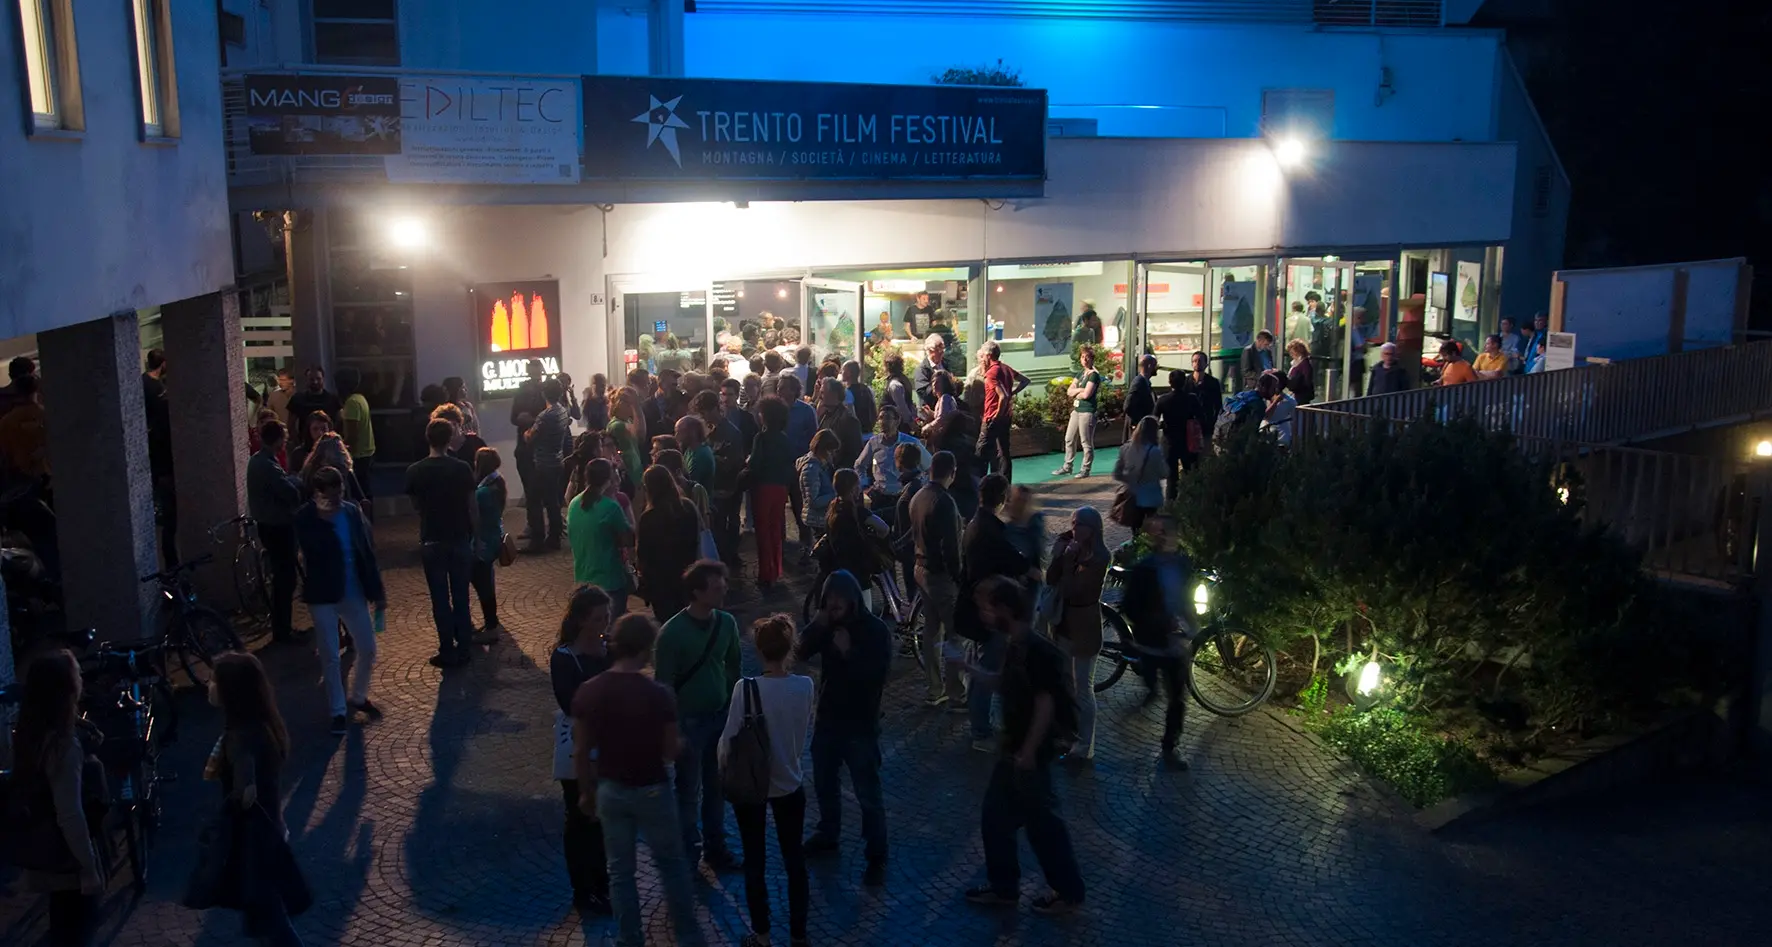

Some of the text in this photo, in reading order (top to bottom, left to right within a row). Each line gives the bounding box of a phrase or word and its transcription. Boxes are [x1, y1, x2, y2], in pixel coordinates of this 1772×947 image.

[697, 111, 1003, 144] TRENTO FILM FESTIVAL
[703, 152, 774, 164] MONTAGNA
[792, 149, 844, 164] SOCIETÀ
[861, 152, 907, 164] CINEMA
[924, 152, 1002, 165] LETTERATURA
[482, 361, 498, 379] G.
